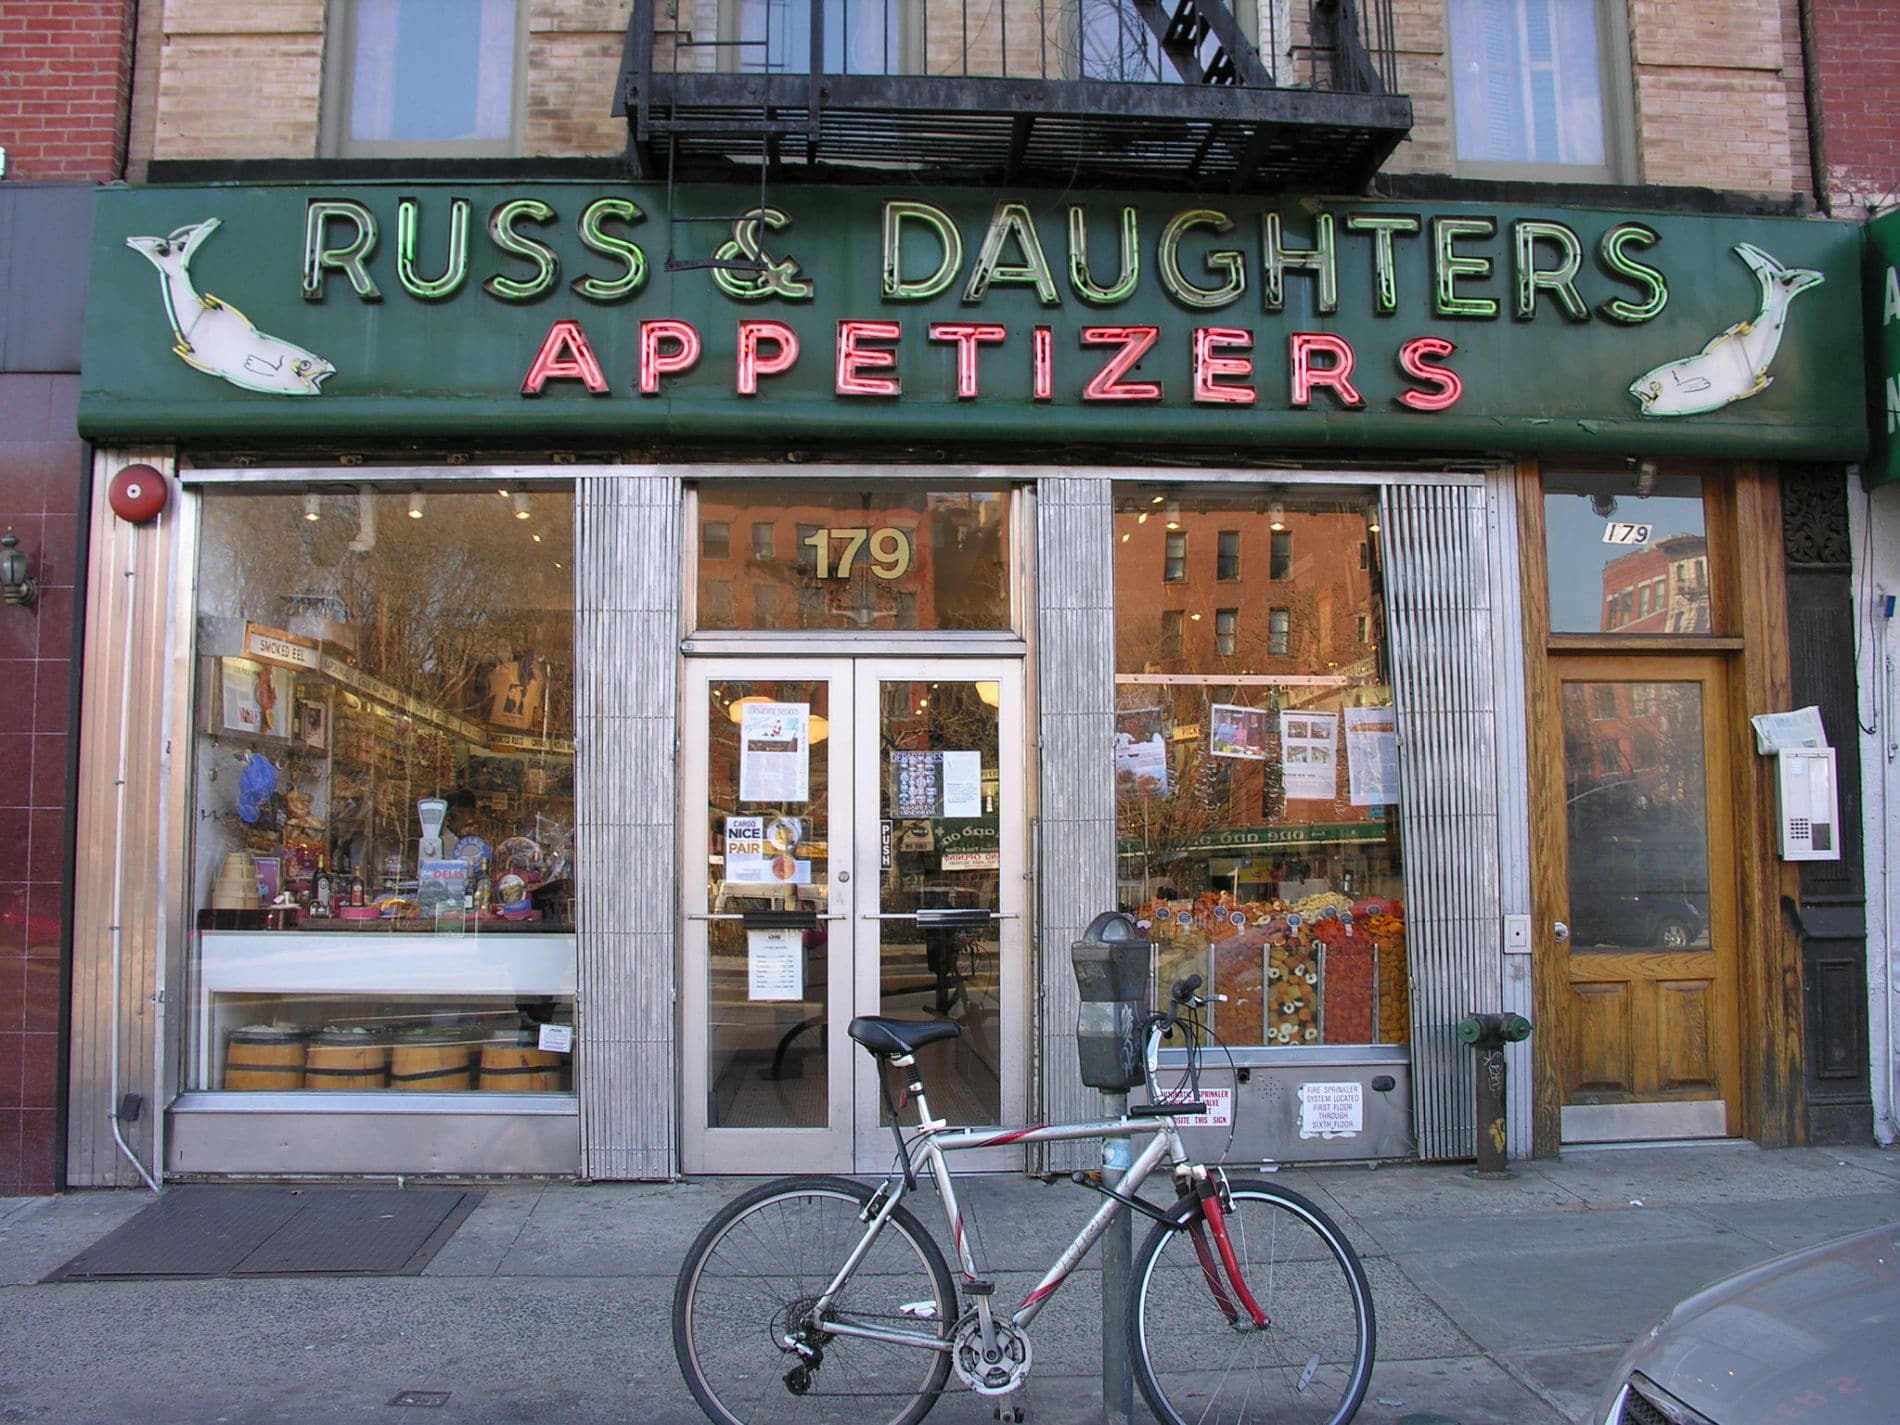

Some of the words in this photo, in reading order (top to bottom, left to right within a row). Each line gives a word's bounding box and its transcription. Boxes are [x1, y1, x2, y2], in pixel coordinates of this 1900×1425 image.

[302, 197, 650, 300] RUSS
[711, 206, 815, 304] &
[880, 199, 1670, 324] DAUGHTERS
[519, 319, 1465, 411] APPETIZERS
[1608, 523, 1648, 543] 179
[803, 527, 910, 579] 179
[260, 639, 289, 658] SMOKED
[292, 647, 305, 662] EEL
[728, 828, 760, 839] NICE
[728, 842, 760, 854] PAIR
[881, 825, 890, 866] PUSH
[433, 870, 465, 880] DELIS
[1307, 1086, 1321, 1094] FIRE
[1324, 1086, 1358, 1094] SPRINKLER
[1313, 1103, 1331, 1111] FIRST
[1333, 1103, 1353, 1111] FLOOR
[1195, 1116, 1208, 1124] THIS
[1212, 1116, 1226, 1124] SIGN
[1319, 1112, 1348, 1120] THROUGH
[1312, 1120, 1331, 1129] SIXTH
[1333, 1120, 1353, 1129] FLOOR
